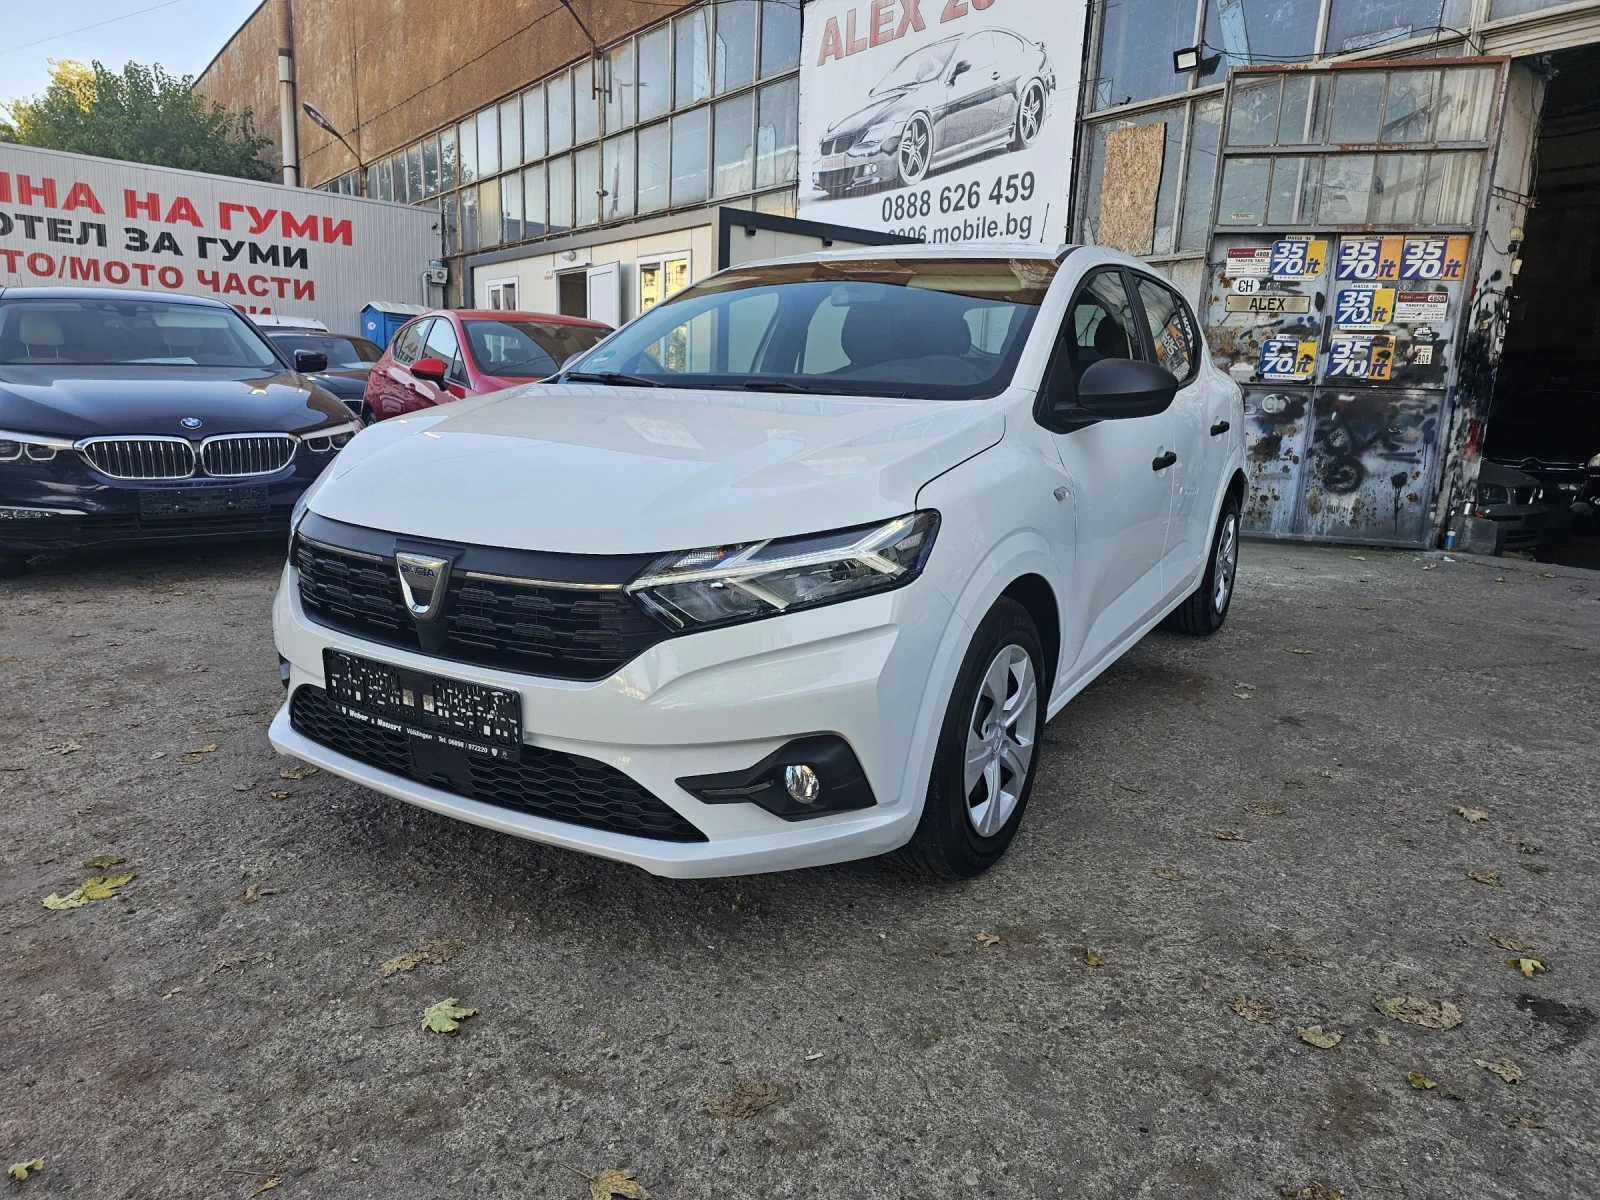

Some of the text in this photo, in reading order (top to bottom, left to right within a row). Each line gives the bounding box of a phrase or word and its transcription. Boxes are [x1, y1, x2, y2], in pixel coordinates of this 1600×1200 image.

[816, 0, 926, 67] ALEX
[882, 170, 1035, 222] 0888 626 459
[124, 188, 204, 228] НА
[219, 201, 353, 246] ГУМИ
[124, 227, 184, 256] ЗА
[197, 236, 308, 269] ГУМИ
[1274, 243, 1306, 258] 35
[1341, 241, 1379, 260] 35
[1405, 241, 1445, 260] 35
[197, 269, 315, 301] ЧАСТИ
[1238, 280, 1254, 292] CH
[1249, 298, 1286, 311] ALEX
[1339, 291, 1373, 307] 35
[1333, 341, 1371, 359] 35
[349, 709, 369, 721] Weber
[438, 736, 447, 744] Tel.
